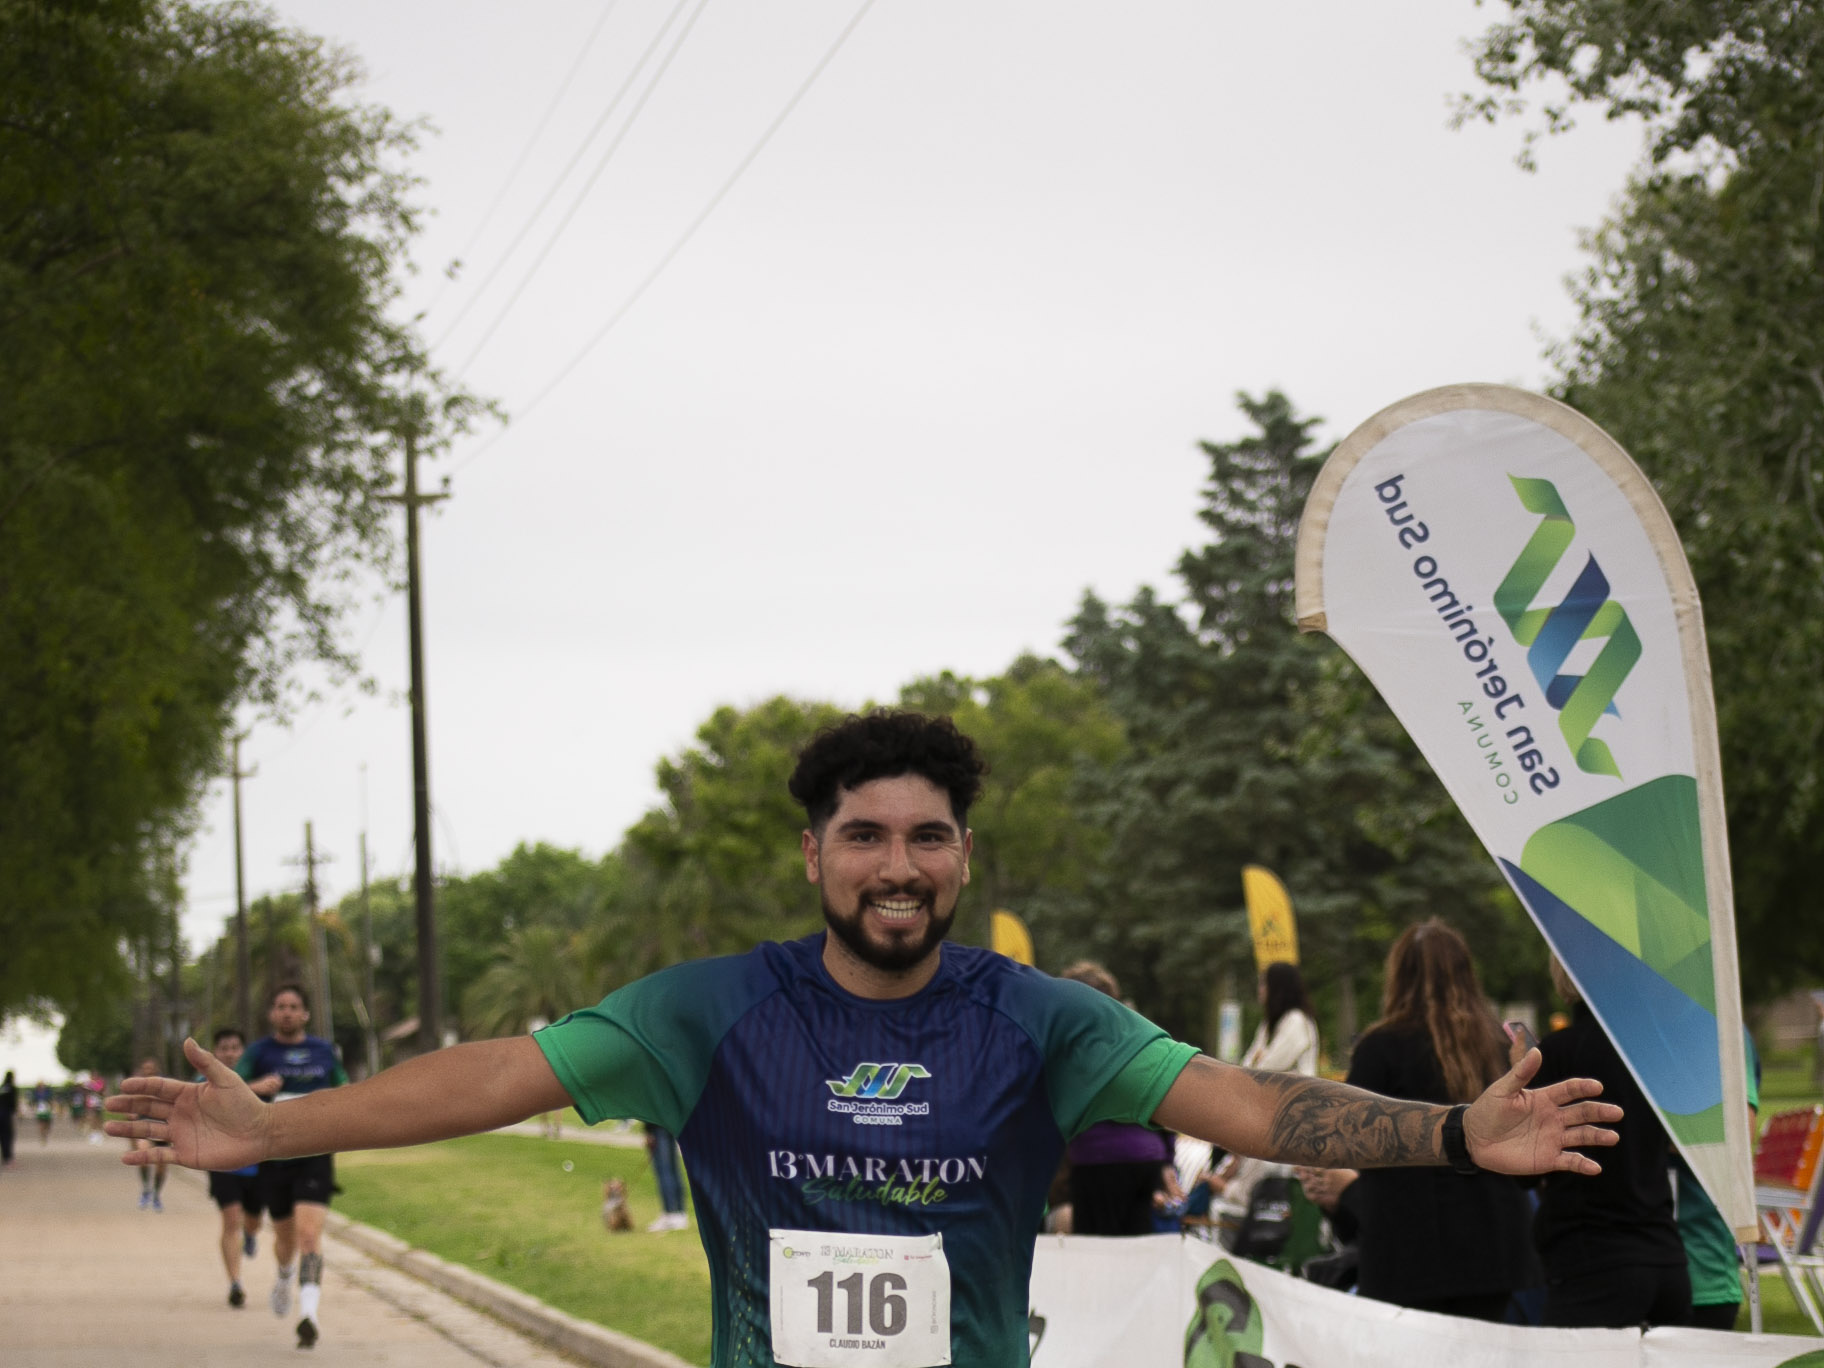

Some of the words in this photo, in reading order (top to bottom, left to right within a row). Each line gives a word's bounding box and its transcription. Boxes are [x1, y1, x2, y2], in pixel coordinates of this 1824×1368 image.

[828, 1101, 850, 1113] San
[852, 1101, 904, 1114] Jerónimo
[906, 1103, 929, 1114] Sud
[853, 1115, 903, 1125] COMUNA
[805, 1154, 988, 1184] MARATON
[801, 1173, 949, 1205] Saludable
[807, 1271, 908, 1336] 116
[829, 1338, 860, 1349] CLAUDIO
